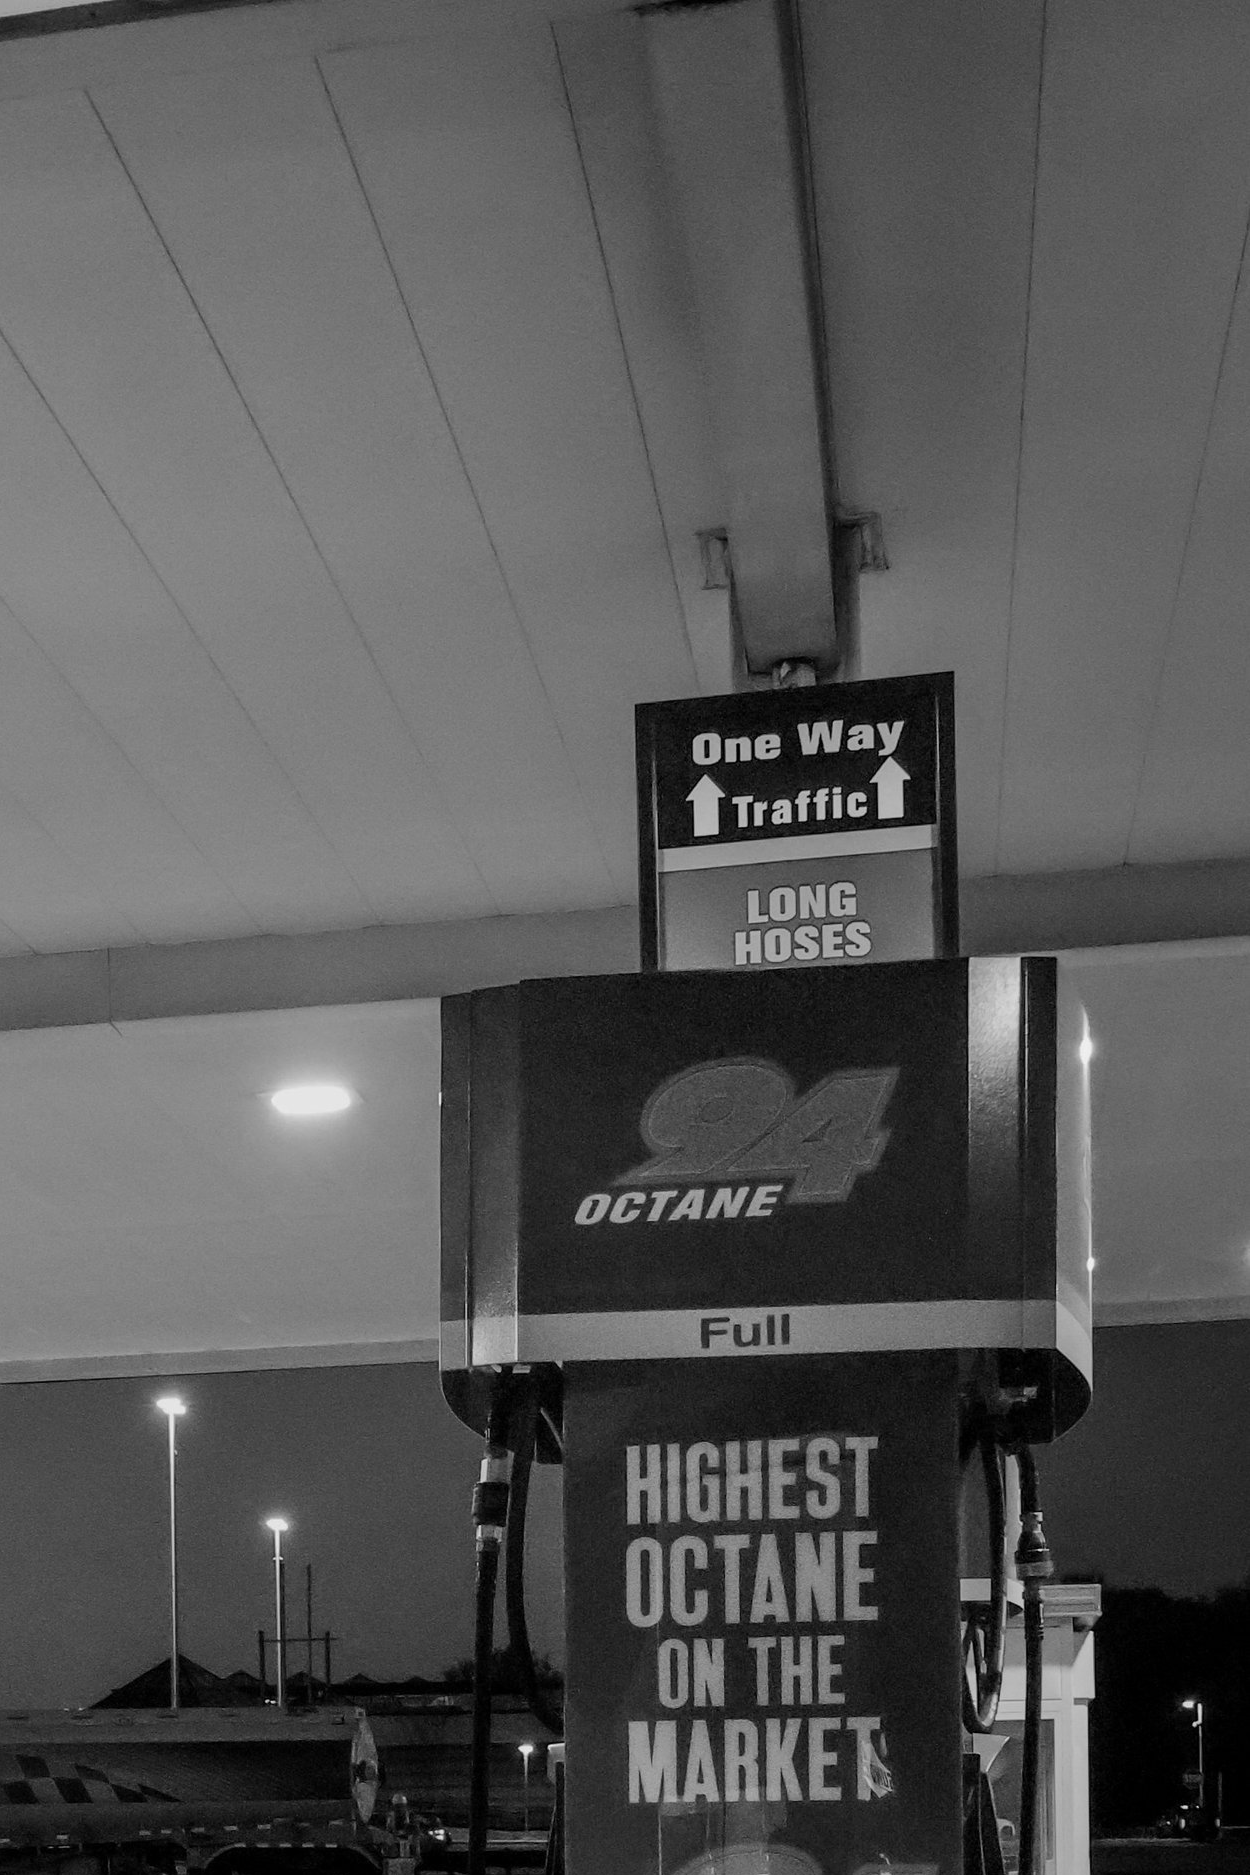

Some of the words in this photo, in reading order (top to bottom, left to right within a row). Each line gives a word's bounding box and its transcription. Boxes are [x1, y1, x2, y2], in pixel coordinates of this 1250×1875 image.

[691, 731, 781, 766] One
[797, 720, 905, 757] Way
[731, 787, 868, 830] Traffic
[746, 881, 857, 926] LONG
[733, 921, 872, 966] HOSES
[618, 1056, 899, 1203] 94
[574, 1185, 784, 1226] OCTANE
[700, 1313, 791, 1349] Full
[625, 1435, 878, 1525] HIGHEST
[625, 1531, 879, 1628] OCTANE
[658, 1637, 725, 1709] ON
[748, 1635, 845, 1706] THE
[627, 1716, 882, 1804] MARKET
